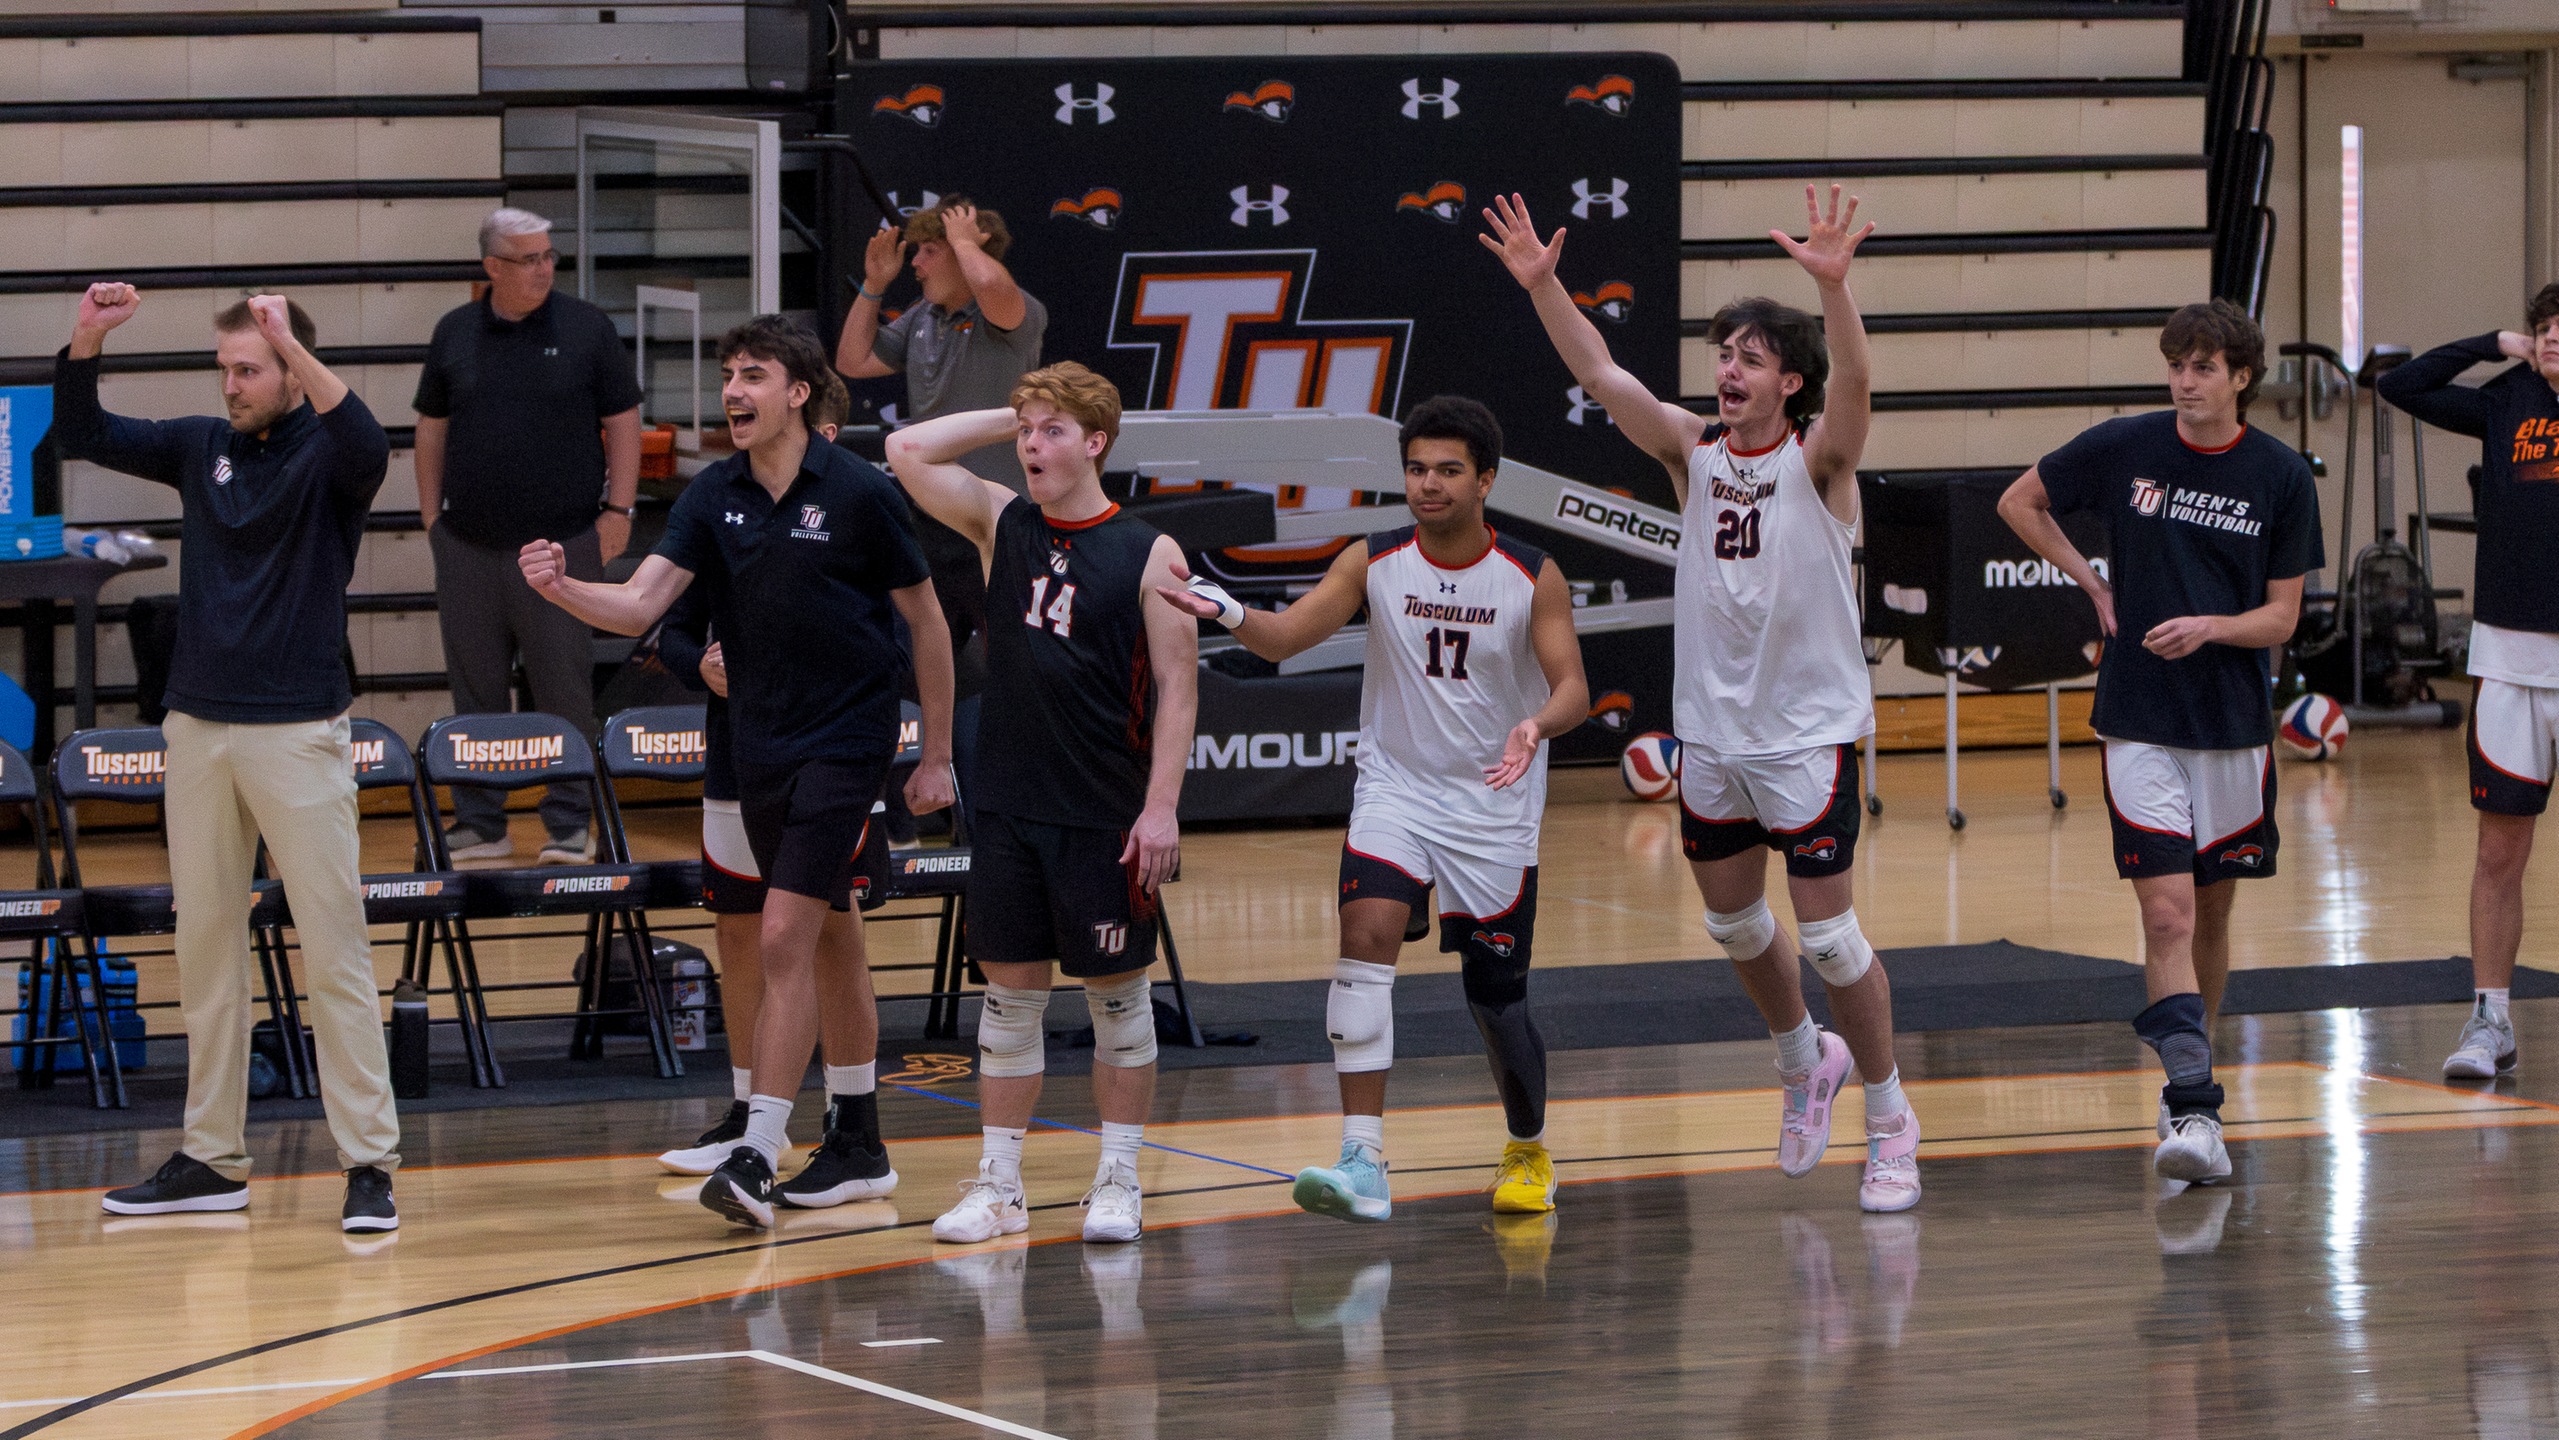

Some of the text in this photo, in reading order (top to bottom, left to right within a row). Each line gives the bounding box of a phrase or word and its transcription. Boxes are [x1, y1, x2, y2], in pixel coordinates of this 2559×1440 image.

[2512, 439, 2547, 463] The
[213, 456, 233, 485] TU
[2131, 478, 2165, 516] TU
[2172, 487, 2250, 516] MEN'S
[801, 505, 825, 530] TU
[2169, 503, 2263, 537] VOLLEYBALL
[790, 531, 830, 541] VOLLEYBALL
[1714, 508, 1762, 560] 20
[1985, 557, 2109, 588] moltn
[1024, 575, 1076, 637] 14
[1404, 594, 1497, 625] TUSCULUM
[1425, 626, 1470, 680] 17
[448, 733, 563, 762] TUSCULUM
[626, 726, 706, 754] TUSCUL
[1186, 731, 1361, 770] MOUR
[81, 746, 167, 775] TUSCUL
[646, 753, 704, 764] PIONEE
[102, 774, 163, 785] PIONEE
[905, 856, 971, 873] #PIONEER
[543, 876, 631, 894] #PIONEERUP
[0, 899, 61, 917] ONEERUP
[1094, 922, 1127, 955] TU
